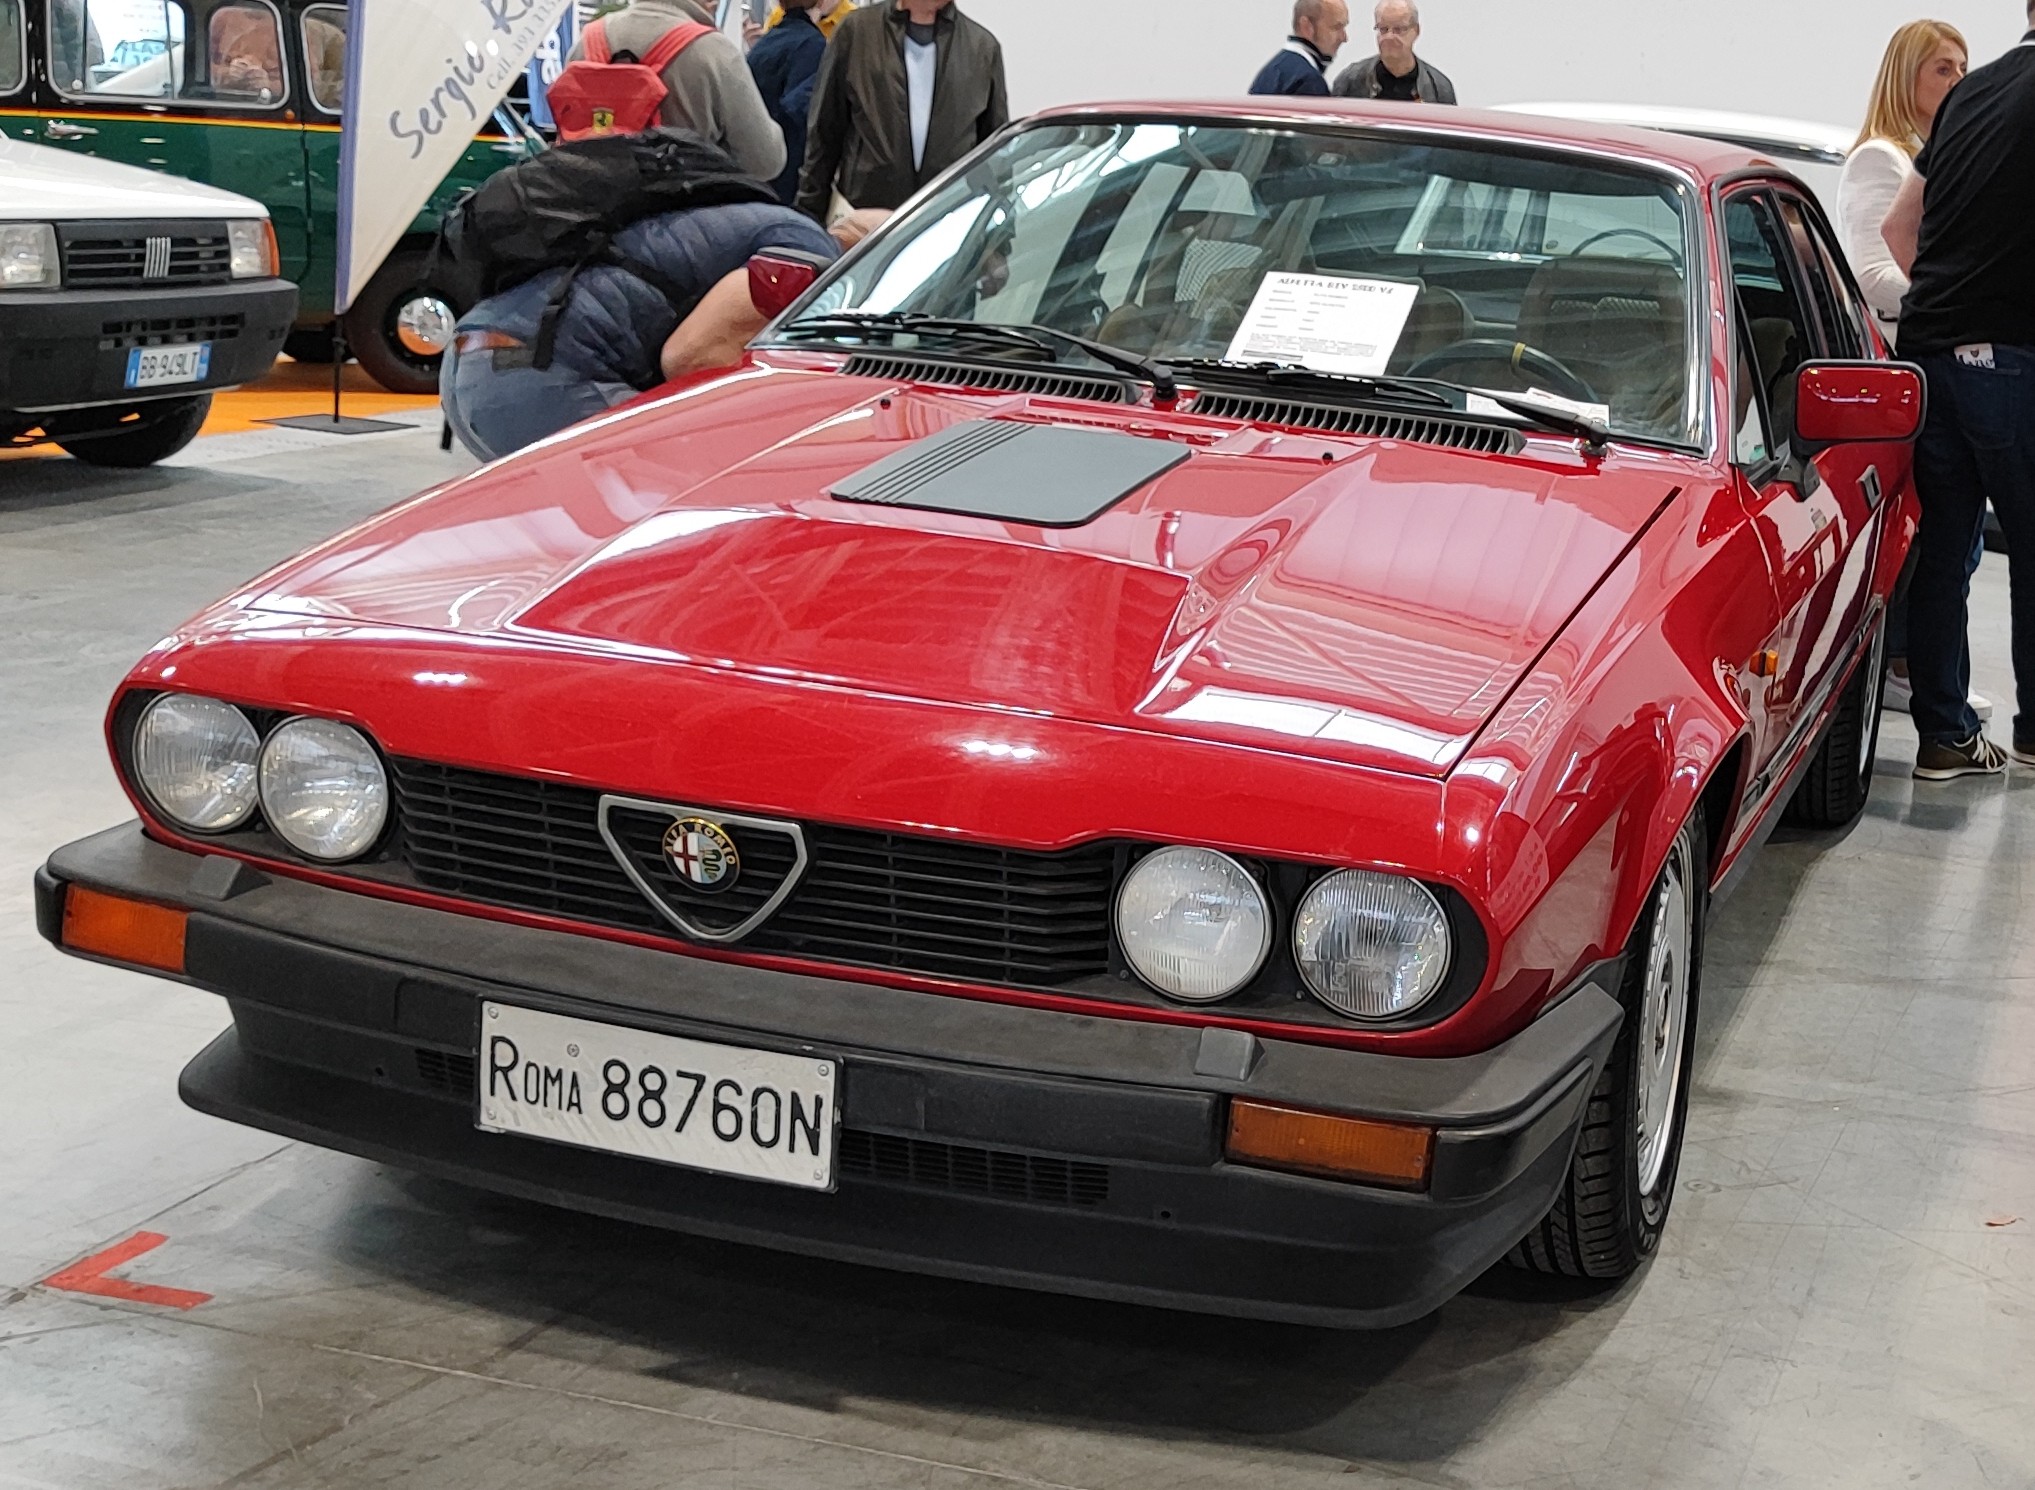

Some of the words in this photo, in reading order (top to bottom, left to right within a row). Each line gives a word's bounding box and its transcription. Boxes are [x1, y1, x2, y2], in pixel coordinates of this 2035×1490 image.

[389, 47, 485, 160] Sergio
[664, 823, 688, 856] ALFA
[694, 823, 736, 865] ROMEO
[601, 1058, 824, 1157] 88760N
